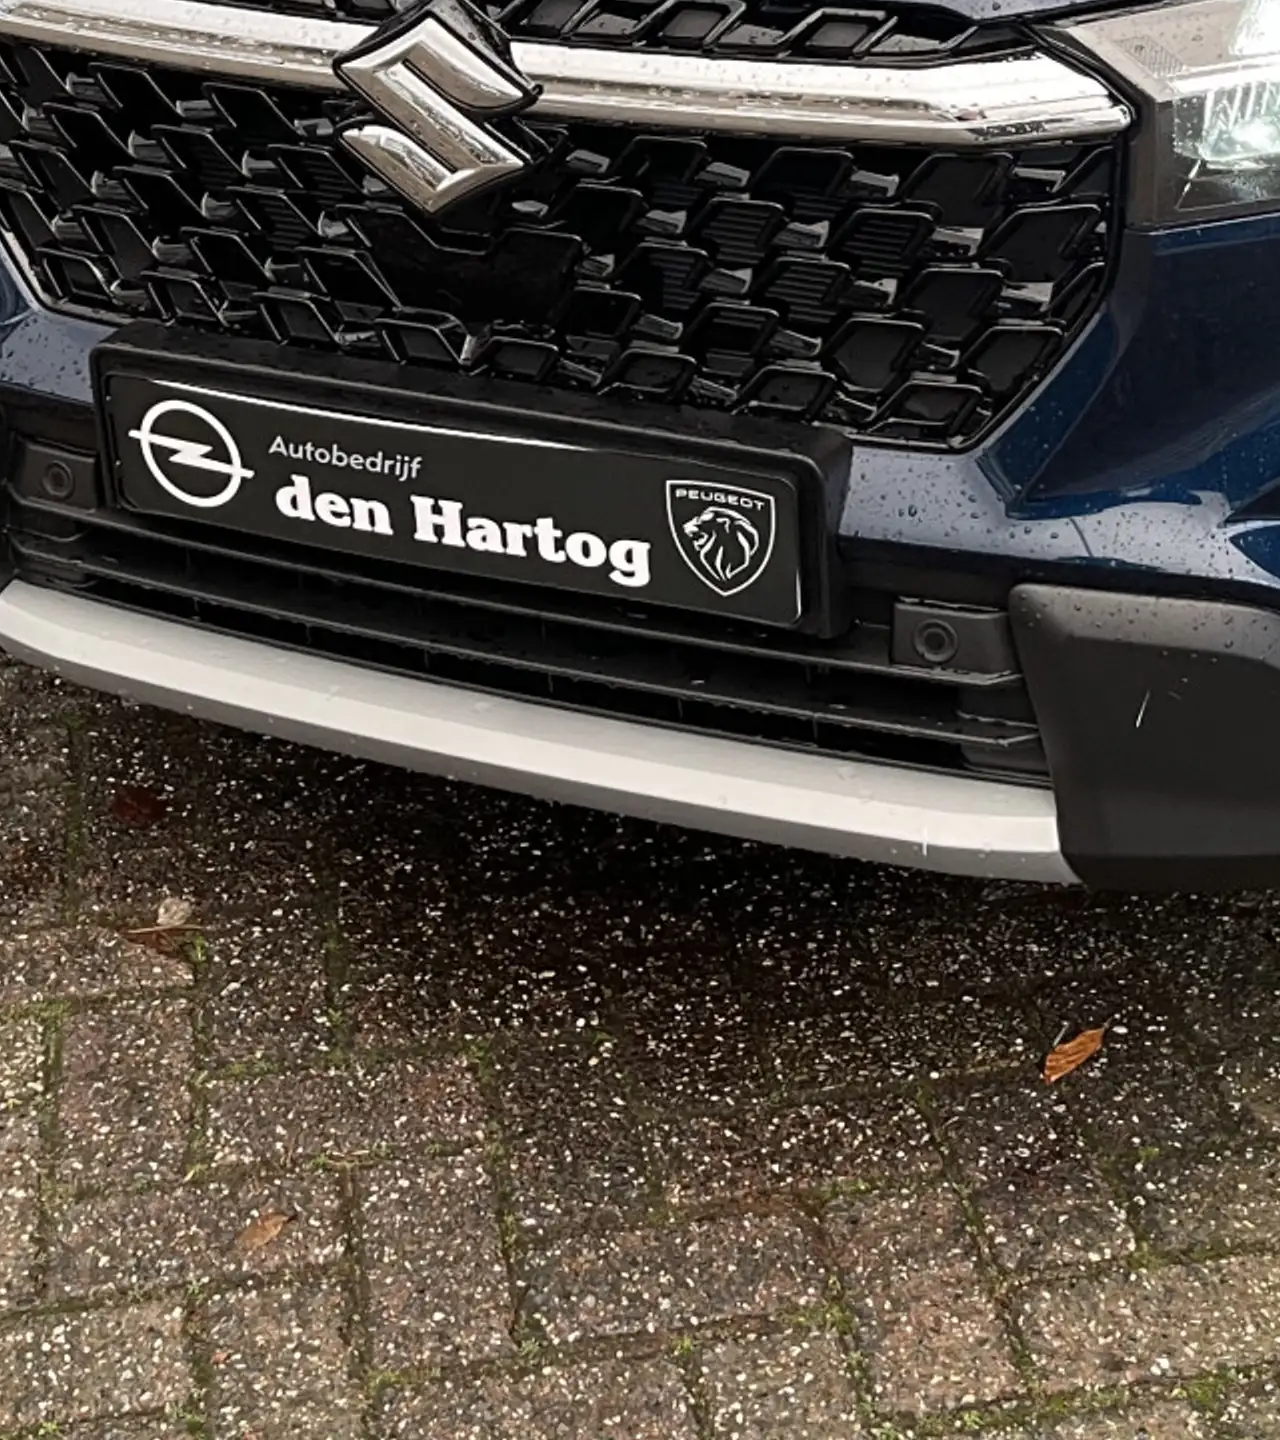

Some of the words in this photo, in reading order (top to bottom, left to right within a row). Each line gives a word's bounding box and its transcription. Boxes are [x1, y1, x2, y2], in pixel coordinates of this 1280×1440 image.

[268, 436, 423, 482] Autobedrijf
[675, 488, 765, 511] PEUGEOT
[276, 474, 394, 536] den
[410, 494, 652, 588] Hartog
